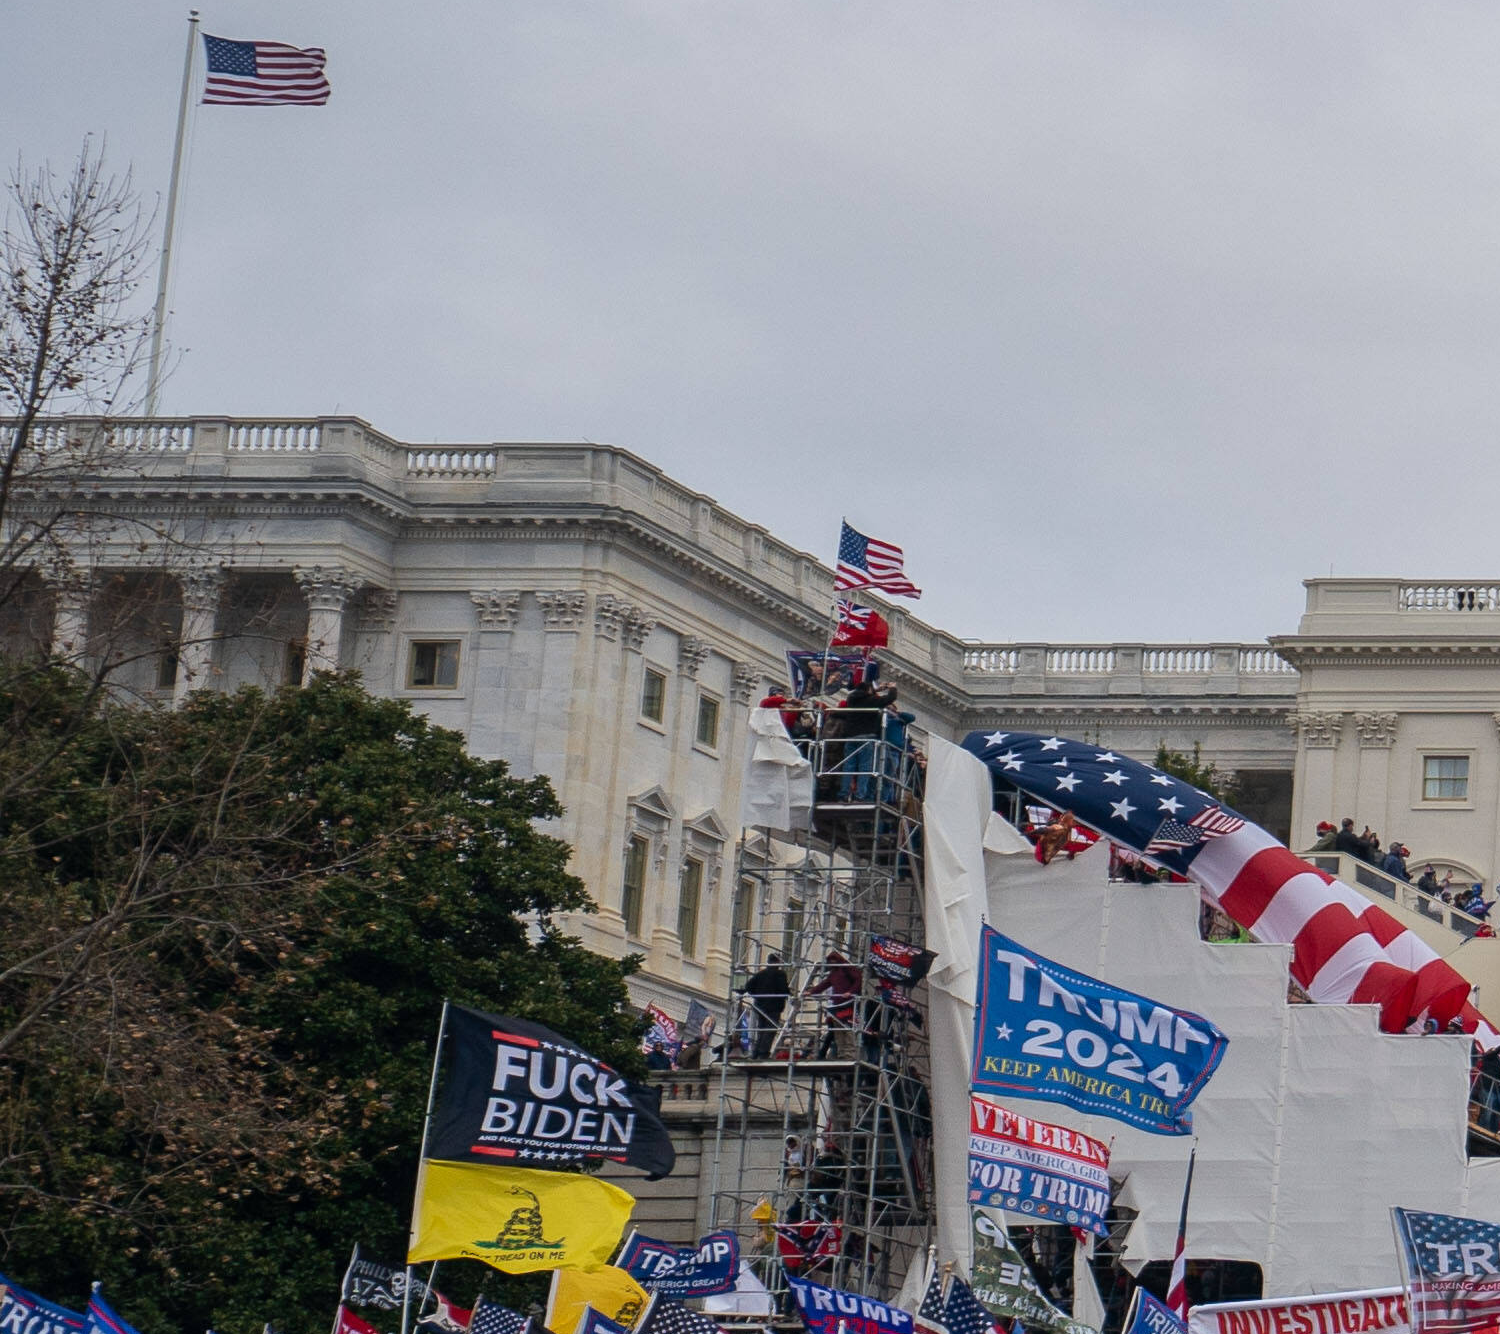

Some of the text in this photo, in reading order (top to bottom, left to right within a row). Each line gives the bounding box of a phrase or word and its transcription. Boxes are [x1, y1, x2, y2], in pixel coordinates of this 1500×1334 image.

[492, 1044, 633, 1107] FUCK
[1021, 1020, 1186, 1097] 2024
[984, 1055, 1175, 1119] KEEP AMERICA TRU
[480, 1097, 635, 1144] BIDEN
[499, 1136, 521, 1145] FUCK
[523, 1137, 543, 1146] YOU
[970, 1138, 1010, 1156] KEEP
[1012, 1144, 1077, 1176] AMERICA
[969, 1158, 1021, 1193] FOR
[495, 1252, 525, 1262] TREAD
[529, 1251, 544, 1259] ON
[643, 1278, 690, 1289] AMERICA
[1432, 1280, 1474, 1292] MAKING
[792, 1280, 911, 1326] TRUMP
